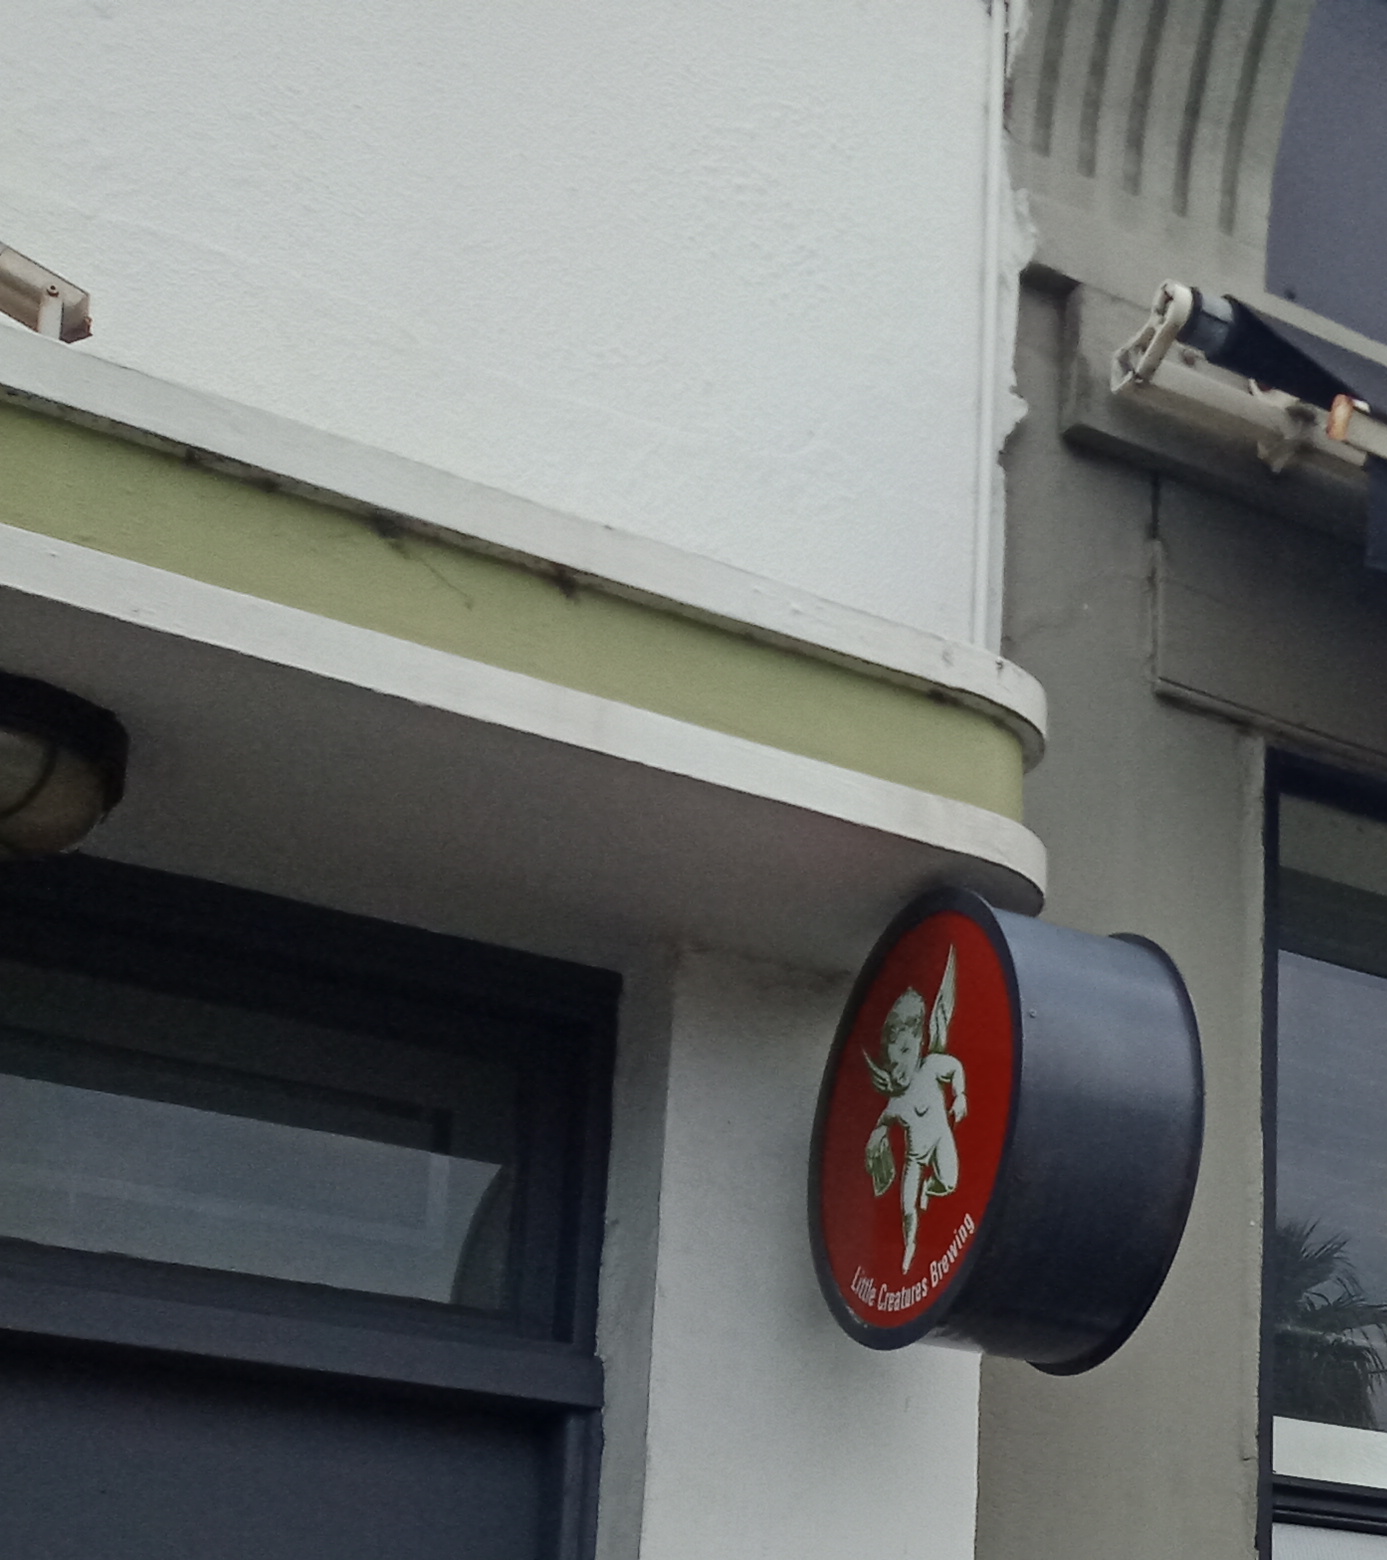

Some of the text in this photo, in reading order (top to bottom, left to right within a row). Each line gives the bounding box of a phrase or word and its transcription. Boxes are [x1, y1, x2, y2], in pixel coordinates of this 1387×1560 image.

[851, 1213, 975, 1312] Little Creatures Brewing
